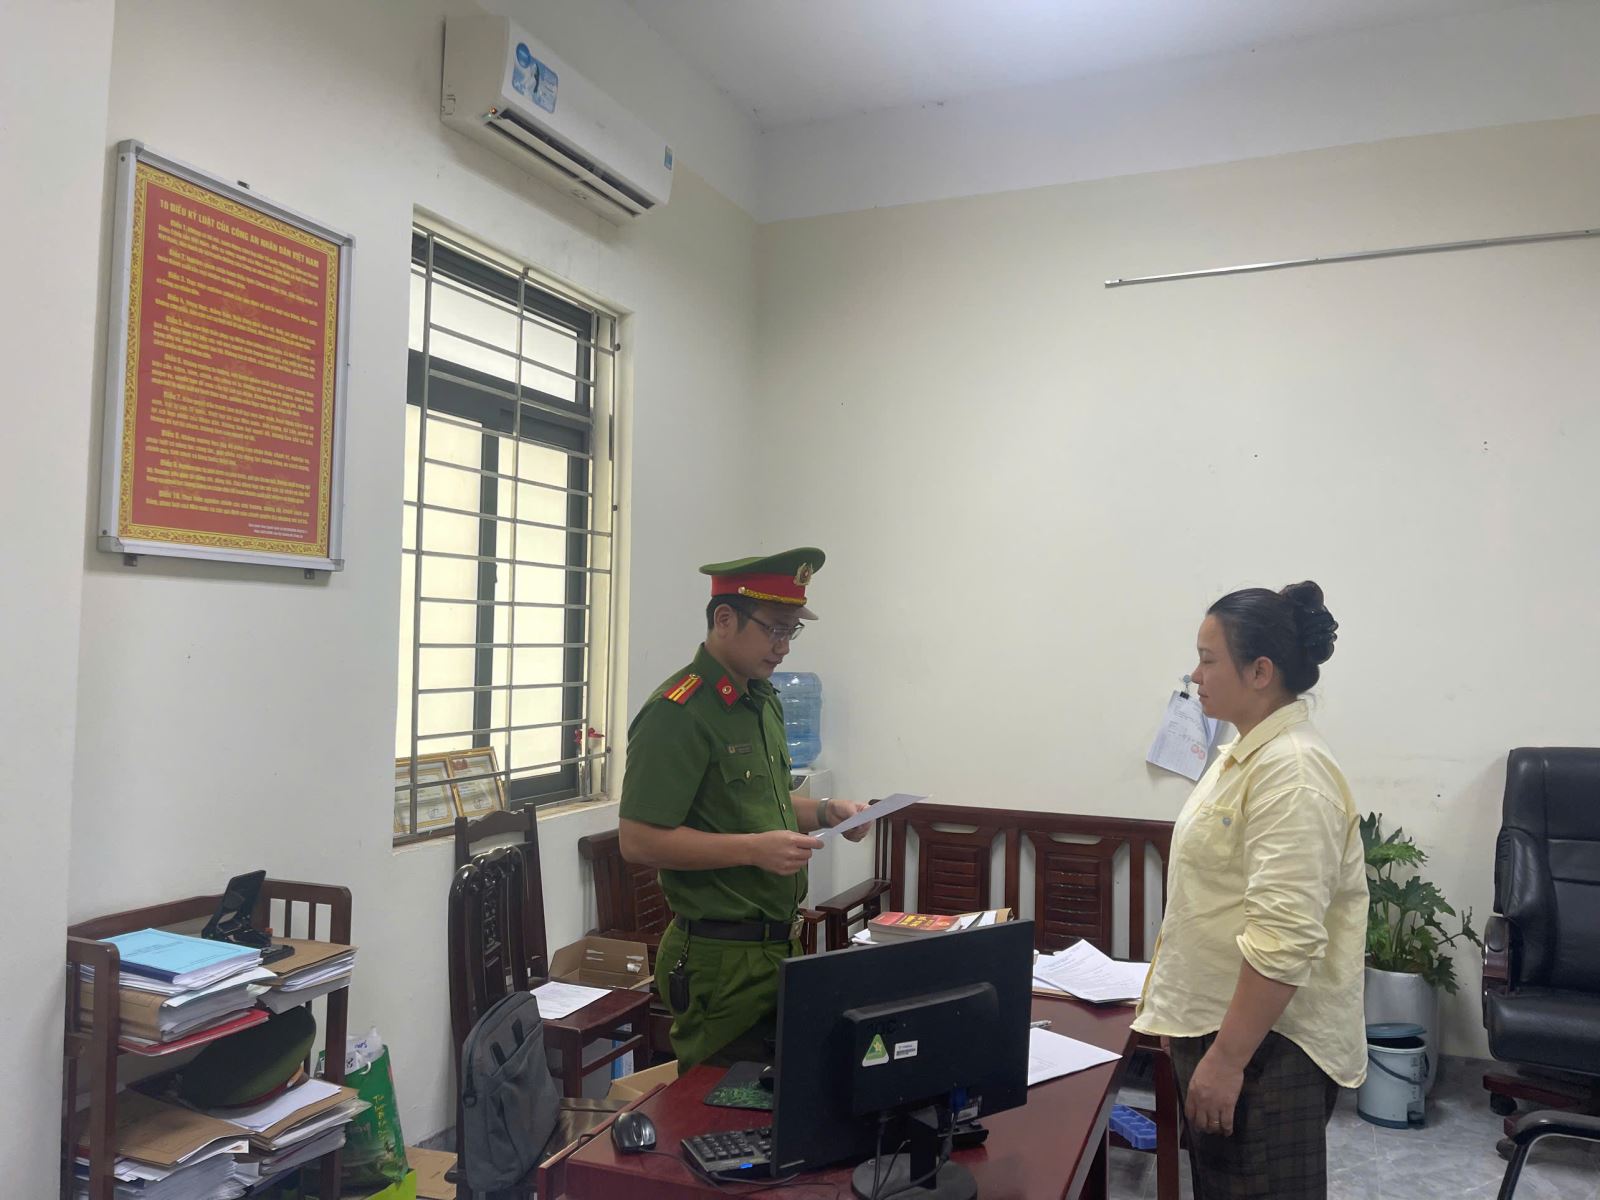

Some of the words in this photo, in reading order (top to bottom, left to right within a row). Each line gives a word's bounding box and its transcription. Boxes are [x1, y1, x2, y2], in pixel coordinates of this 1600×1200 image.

[160, 199, 168, 209] 10
[170, 203, 186, 216] ĐIỀU
[198, 213, 215, 227] LUẬT
[216, 220, 229, 234] CỦA
[231, 226, 249, 241] CÔNG
[250, 234, 260, 244] AN
[260, 239, 278, 252] NHÂN
[279, 246, 292, 258] DÂN
[292, 250, 305, 264] VIỆT
[306, 256, 319, 268] NAM
